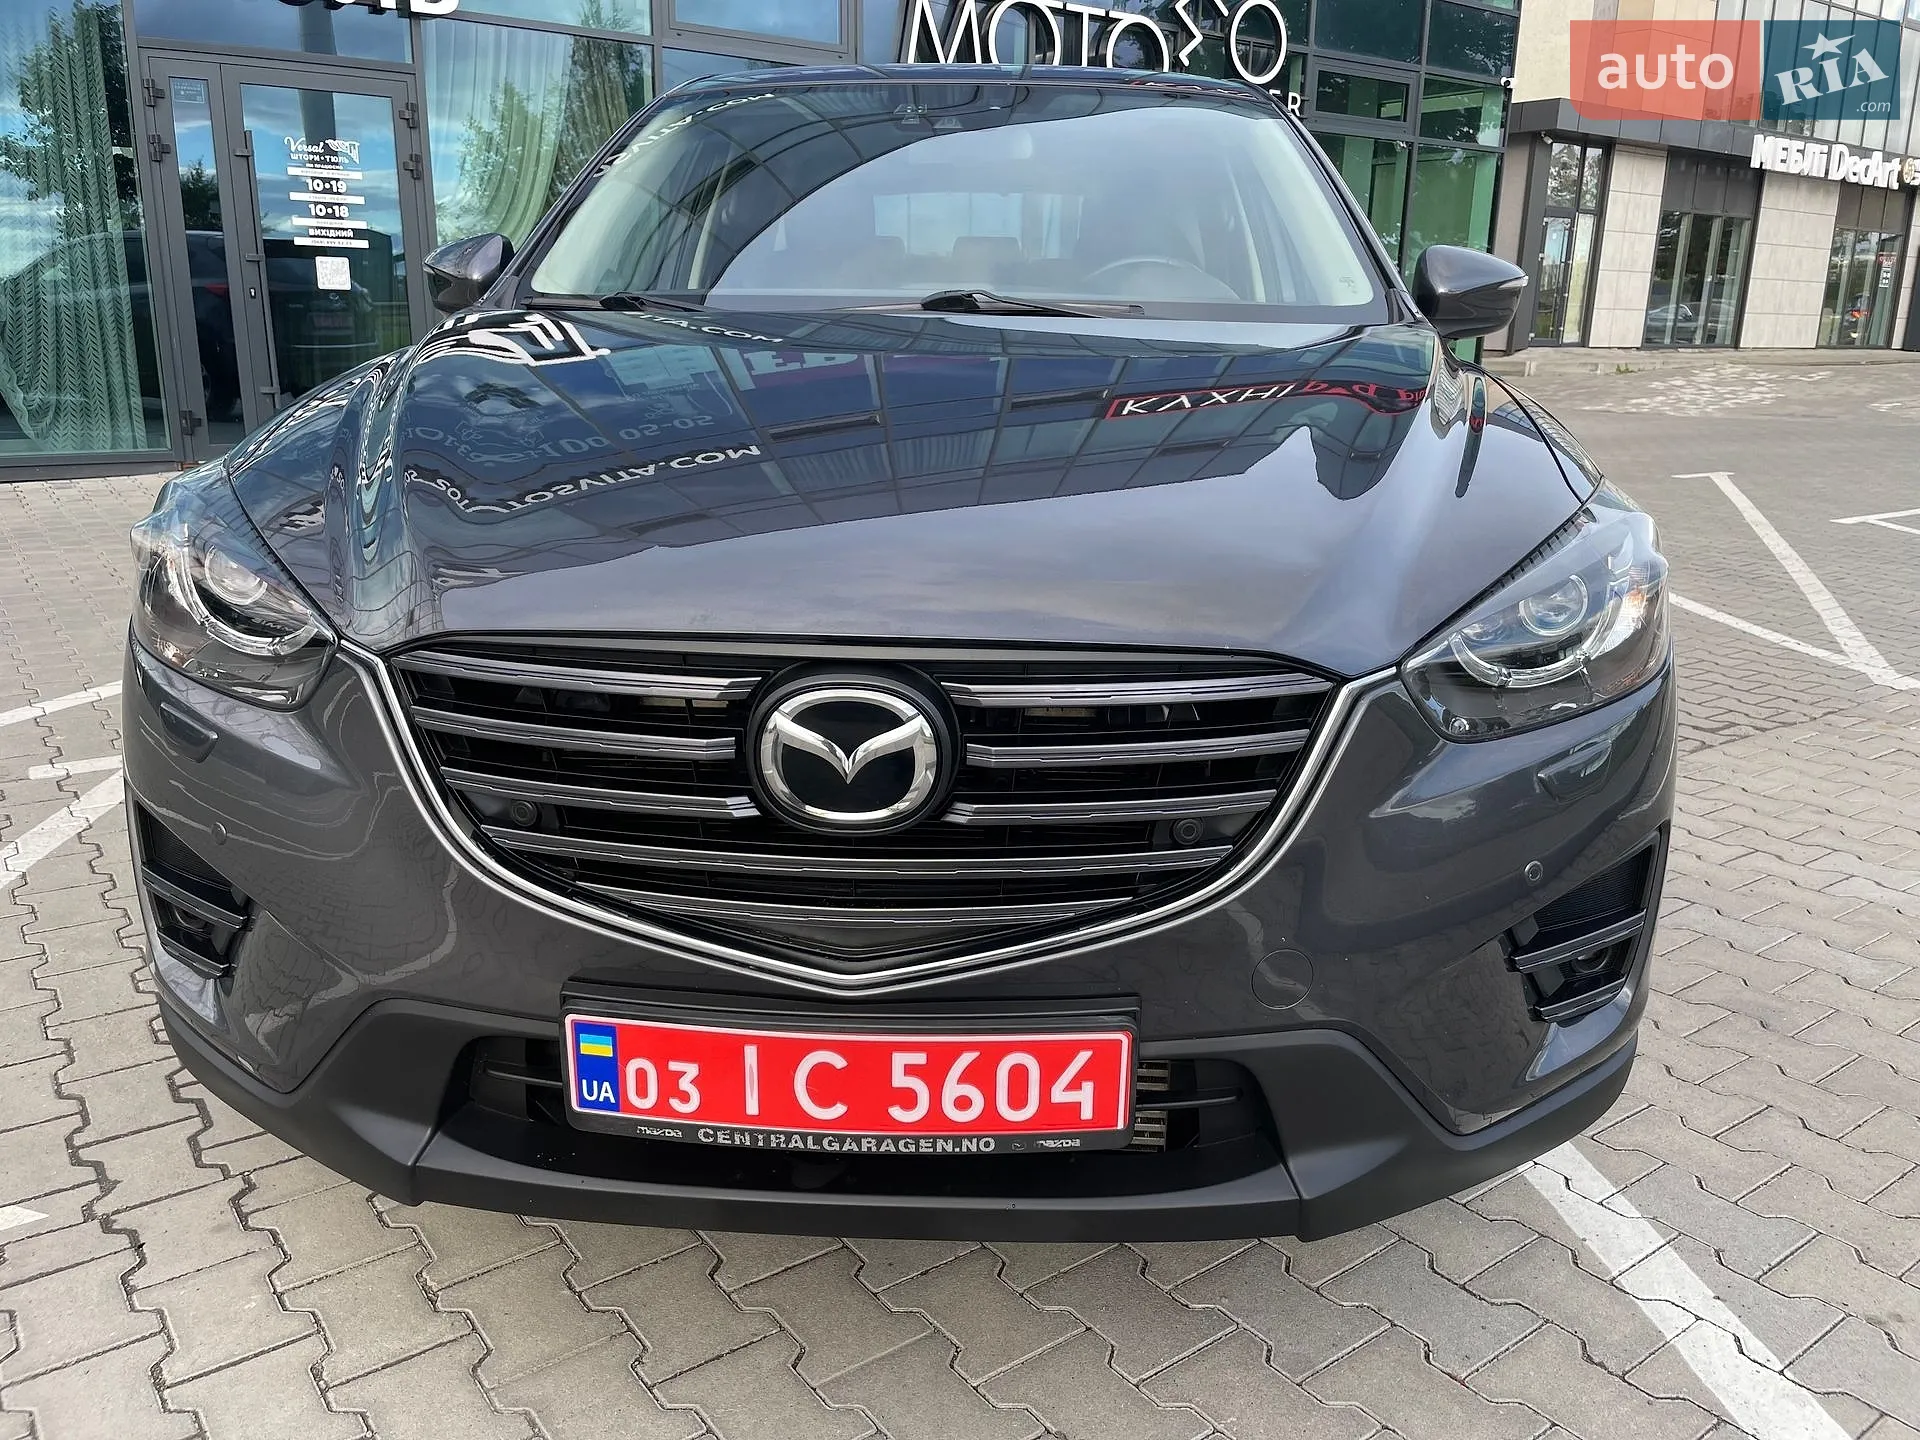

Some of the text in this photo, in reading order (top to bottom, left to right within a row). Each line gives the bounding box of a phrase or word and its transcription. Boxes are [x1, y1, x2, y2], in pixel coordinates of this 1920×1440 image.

[284, 136, 324, 153] Versal
[1827, 143, 1901, 190] DecArt
[308, 228, 354, 238] ВИХІДНИЙ
[582, 1079, 616, 1103] UA
[625, 1057, 701, 1114] 03
[887, 1050, 1094, 1123] 5604
[697, 1127, 995, 1153] CENTRALGARAGEN.NO
